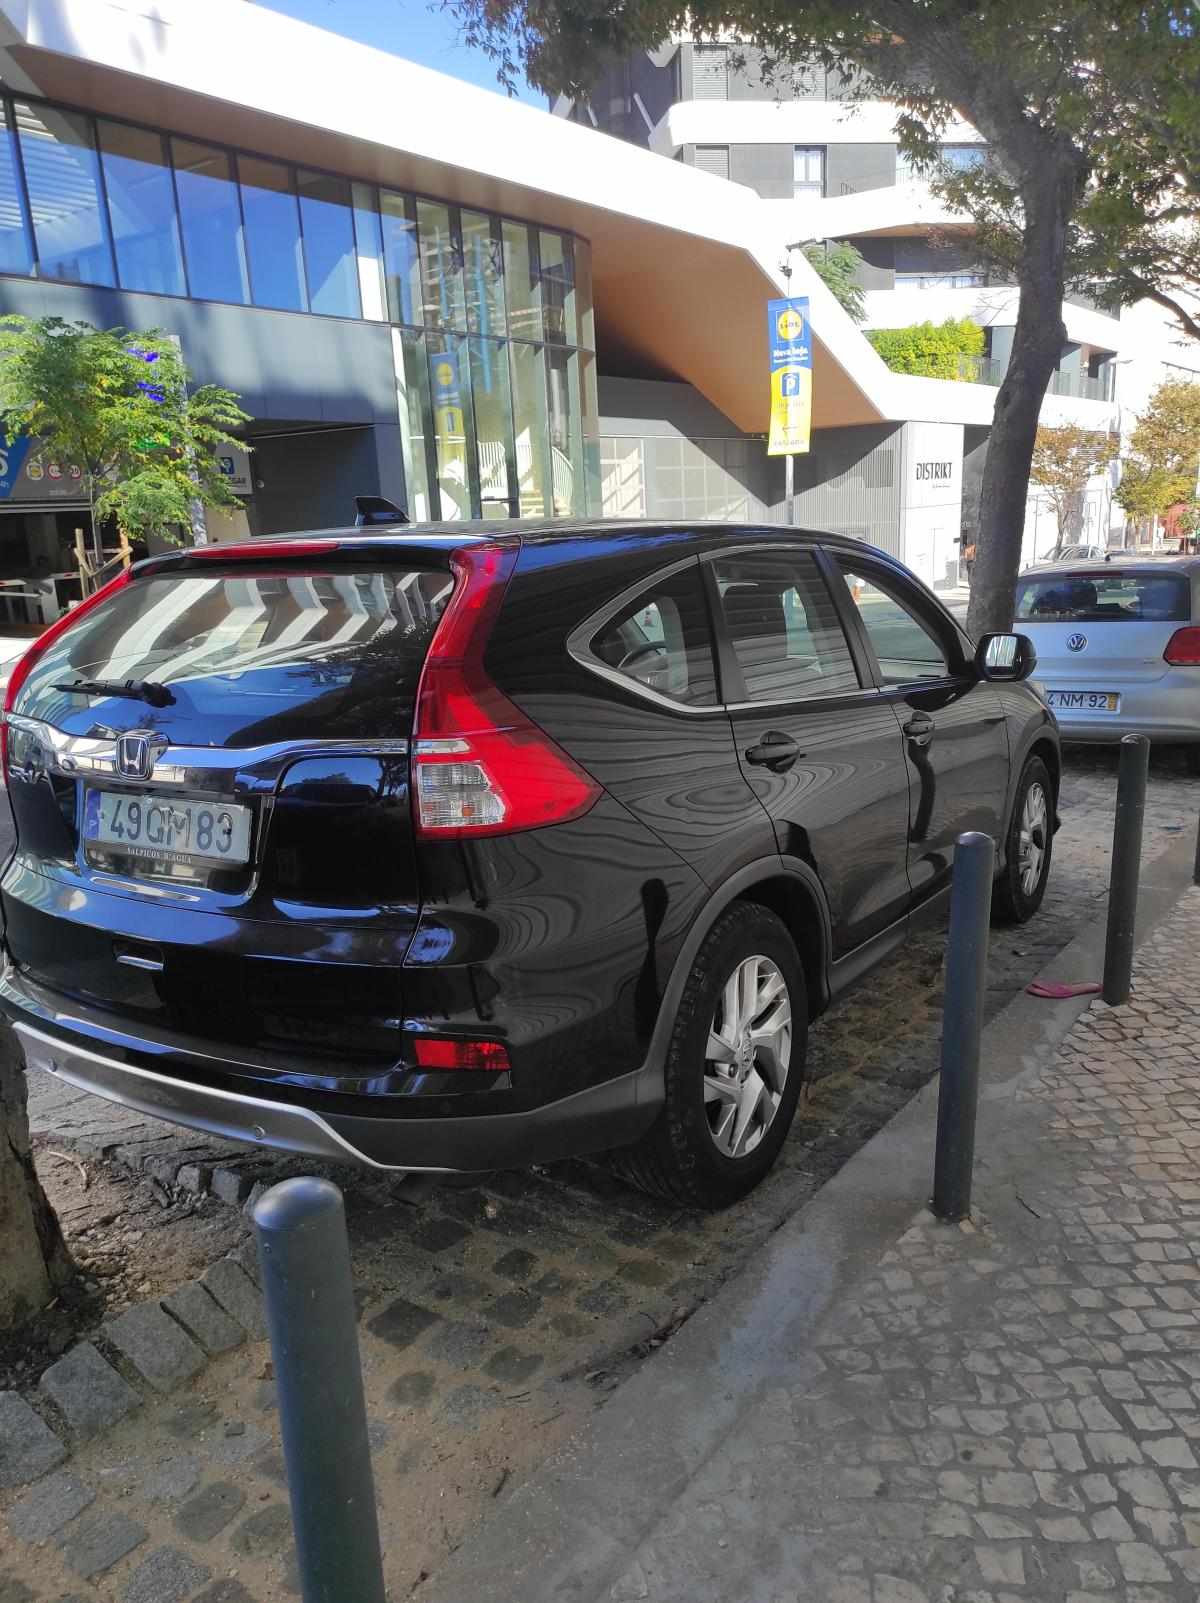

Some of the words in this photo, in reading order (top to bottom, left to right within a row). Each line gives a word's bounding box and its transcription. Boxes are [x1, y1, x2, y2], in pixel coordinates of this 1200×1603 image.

[916, 462, 952, 480] DISTRIKT
[1060, 693, 1084, 707] NM
[1088, 694, 1108, 708] 92
